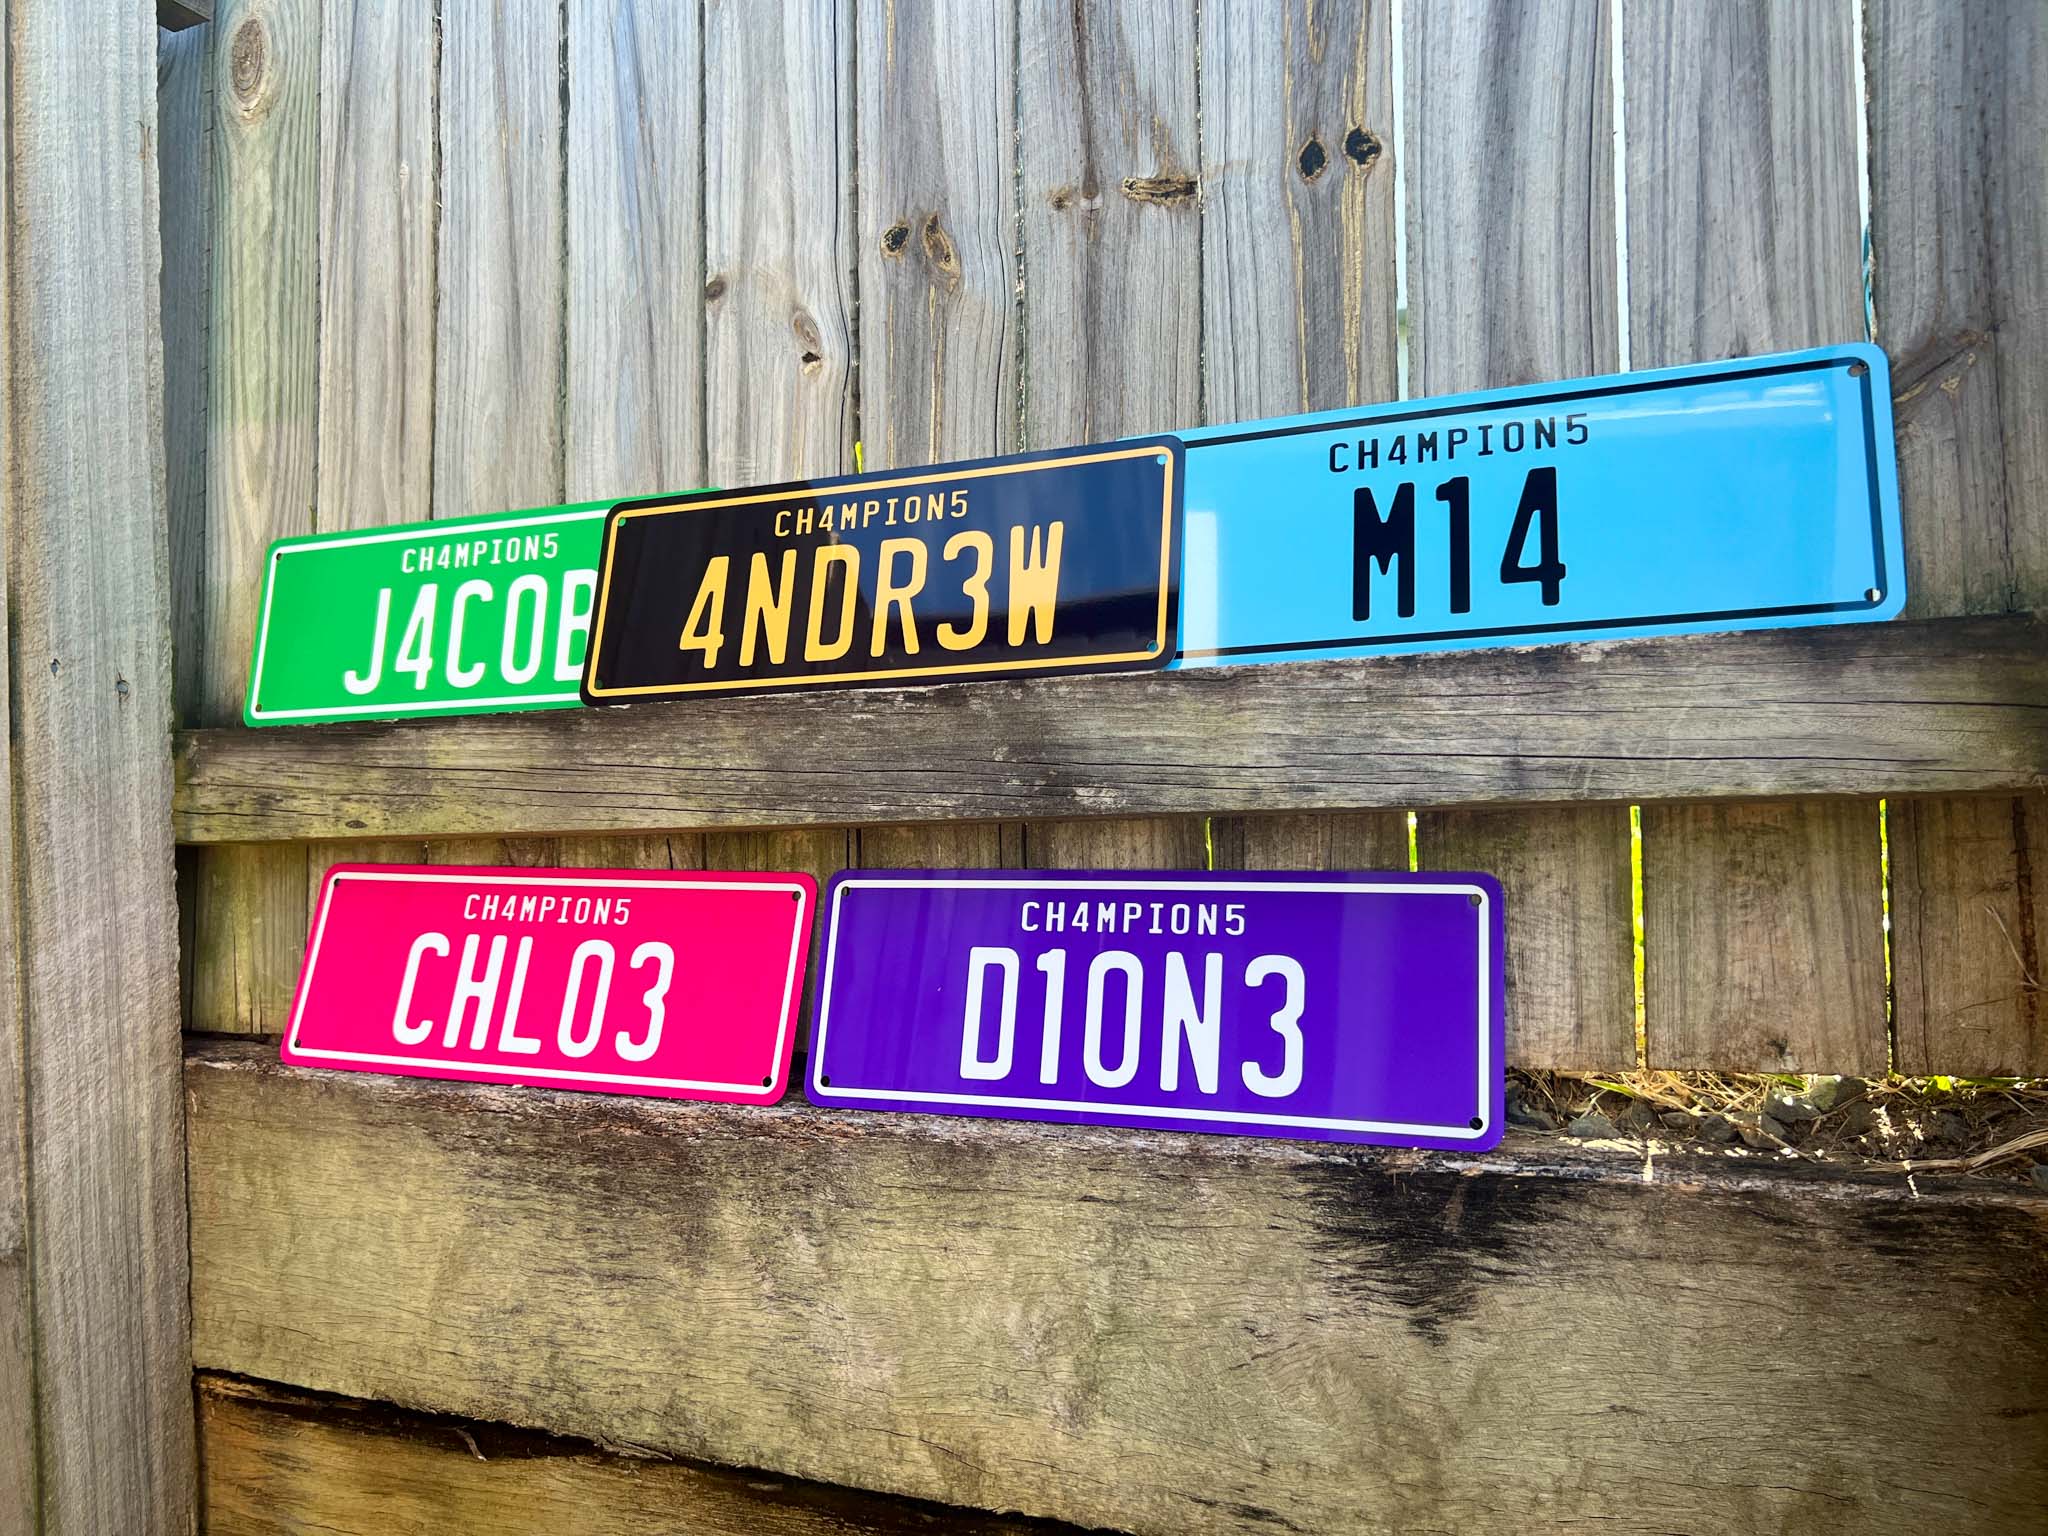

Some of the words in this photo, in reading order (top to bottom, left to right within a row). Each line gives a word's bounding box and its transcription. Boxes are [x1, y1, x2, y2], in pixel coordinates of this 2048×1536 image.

[1329, 413, 1589, 473] CH4MPION5
[774, 490, 969, 537] CH4MPION5
[401, 532, 559, 574] CH4MPION5
[1352, 466, 1567, 622] M14
[679, 521, 1064, 669] 4NDR3W
[463, 893, 632, 925] CH4MPION5
[1020, 901, 1246, 937] CH4MPION5
